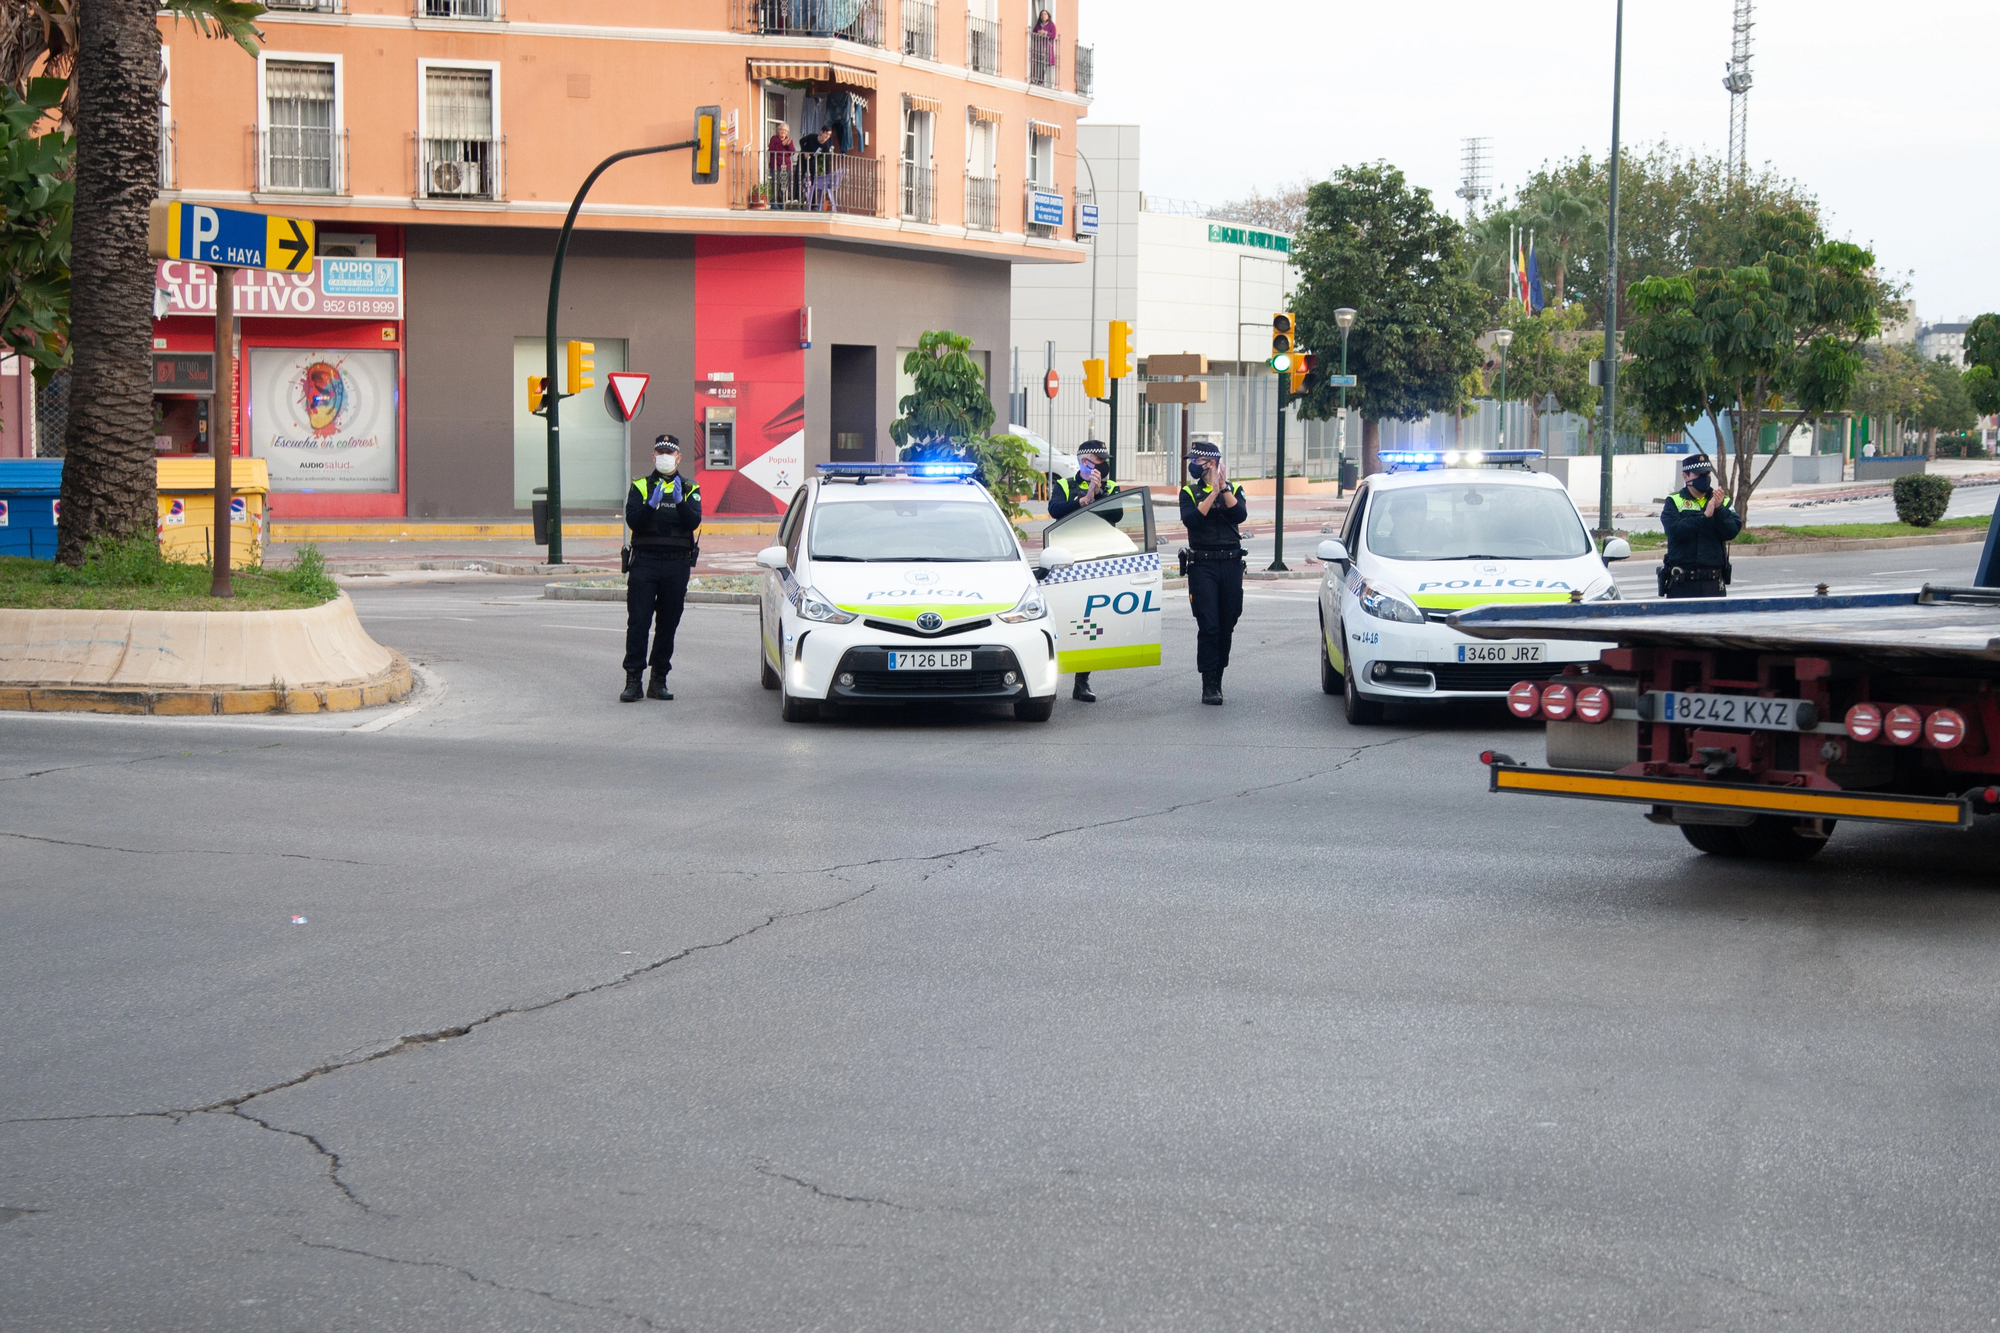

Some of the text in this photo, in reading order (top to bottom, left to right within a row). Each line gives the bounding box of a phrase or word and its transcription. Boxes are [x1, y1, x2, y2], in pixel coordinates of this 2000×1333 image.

[192, 205, 220, 260] P
[210, 245, 261, 265] C. HAYA
[329, 261, 373, 273] AUDIO
[323, 299, 395, 314] 952 618 999
[274, 436, 375, 449] Escucha en colores
[768, 456, 797, 465] Popular
[1418, 578, 1571, 592] POLICÍA
[1083, 590, 1161, 618] POL
[1361, 631, 1379, 645] 14-16
[899, 653, 968, 668] 7126 LBP
[1468, 647, 1506, 661] 3460
[1511, 647, 1540, 661] JRZ
[1679, 697, 1735, 722] 8242
[1744, 701, 1788, 725] KXZ
